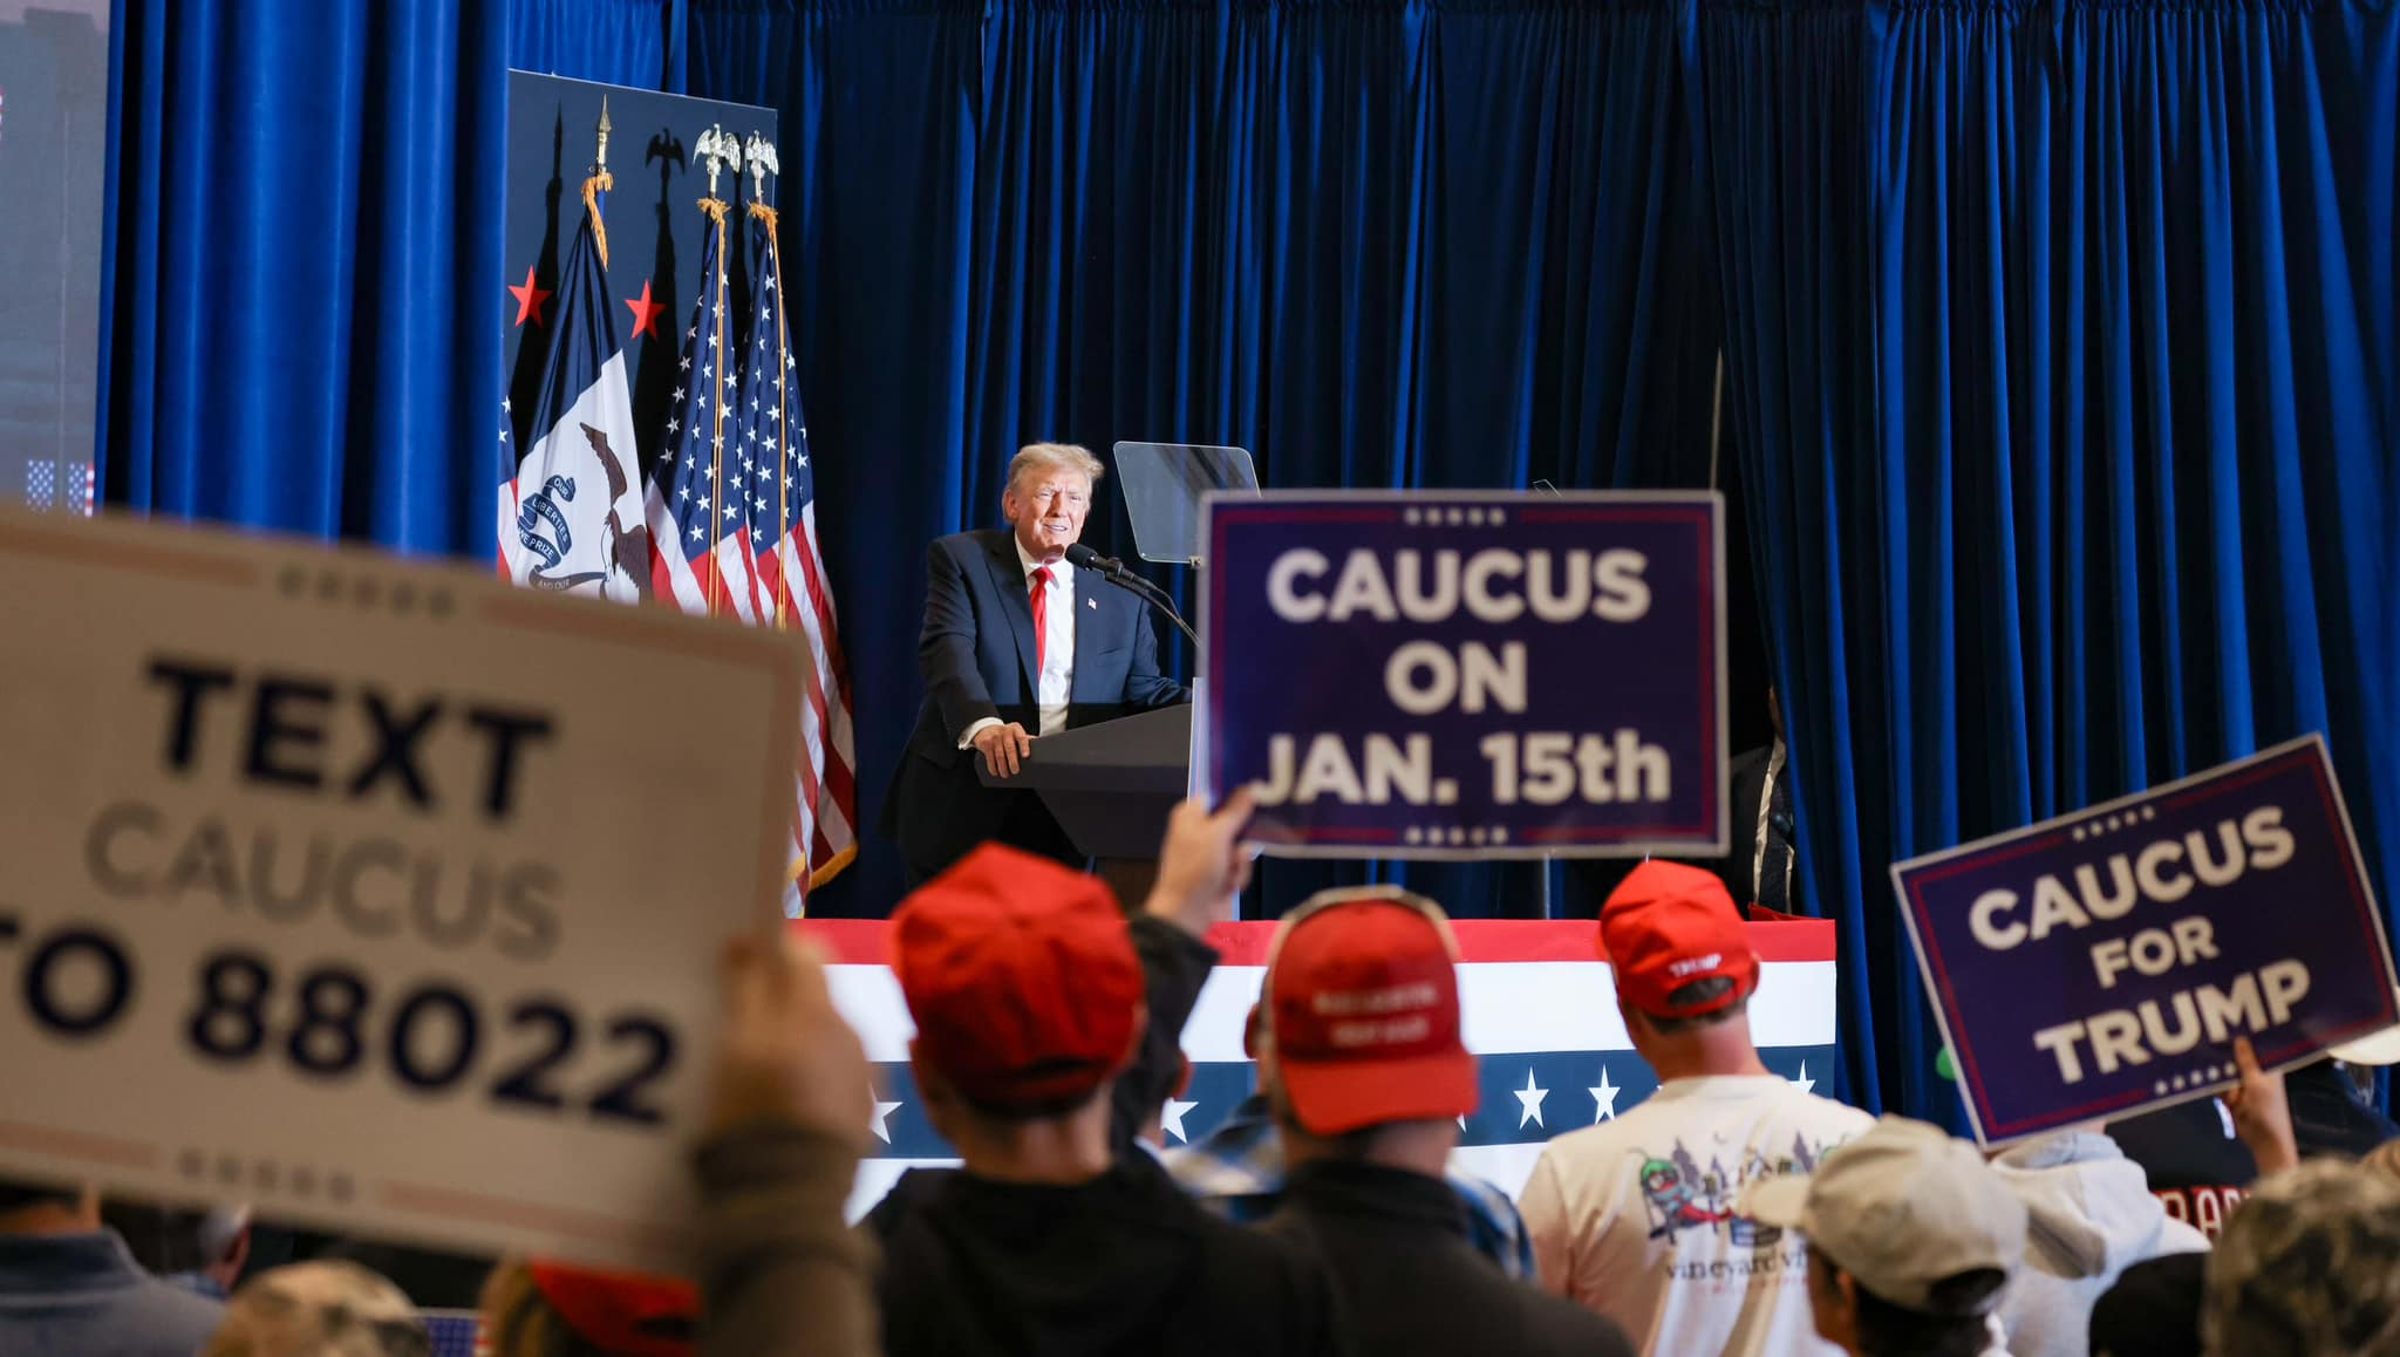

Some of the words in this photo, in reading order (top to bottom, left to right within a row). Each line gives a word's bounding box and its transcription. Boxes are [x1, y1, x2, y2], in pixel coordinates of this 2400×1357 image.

[532, 498, 569, 543] LIBERTIES
[554, 477, 570, 498] OUR
[530, 538, 554, 560] PRIZE
[1267, 547, 1651, 623] CAUCUS
[1385, 640, 1528, 715] ON
[146, 655, 555, 823] TEXT
[1251, 732, 1459, 806] JAN.
[1479, 728, 1672, 804] 15th
[85, 801, 562, 961] CAUCUS
[1969, 805, 2295, 951] CAUCUS
[2089, 916, 2220, 989] FOR
[184, 950, 681, 1126] 88022
[2033, 958, 2311, 1084] TRUMP
